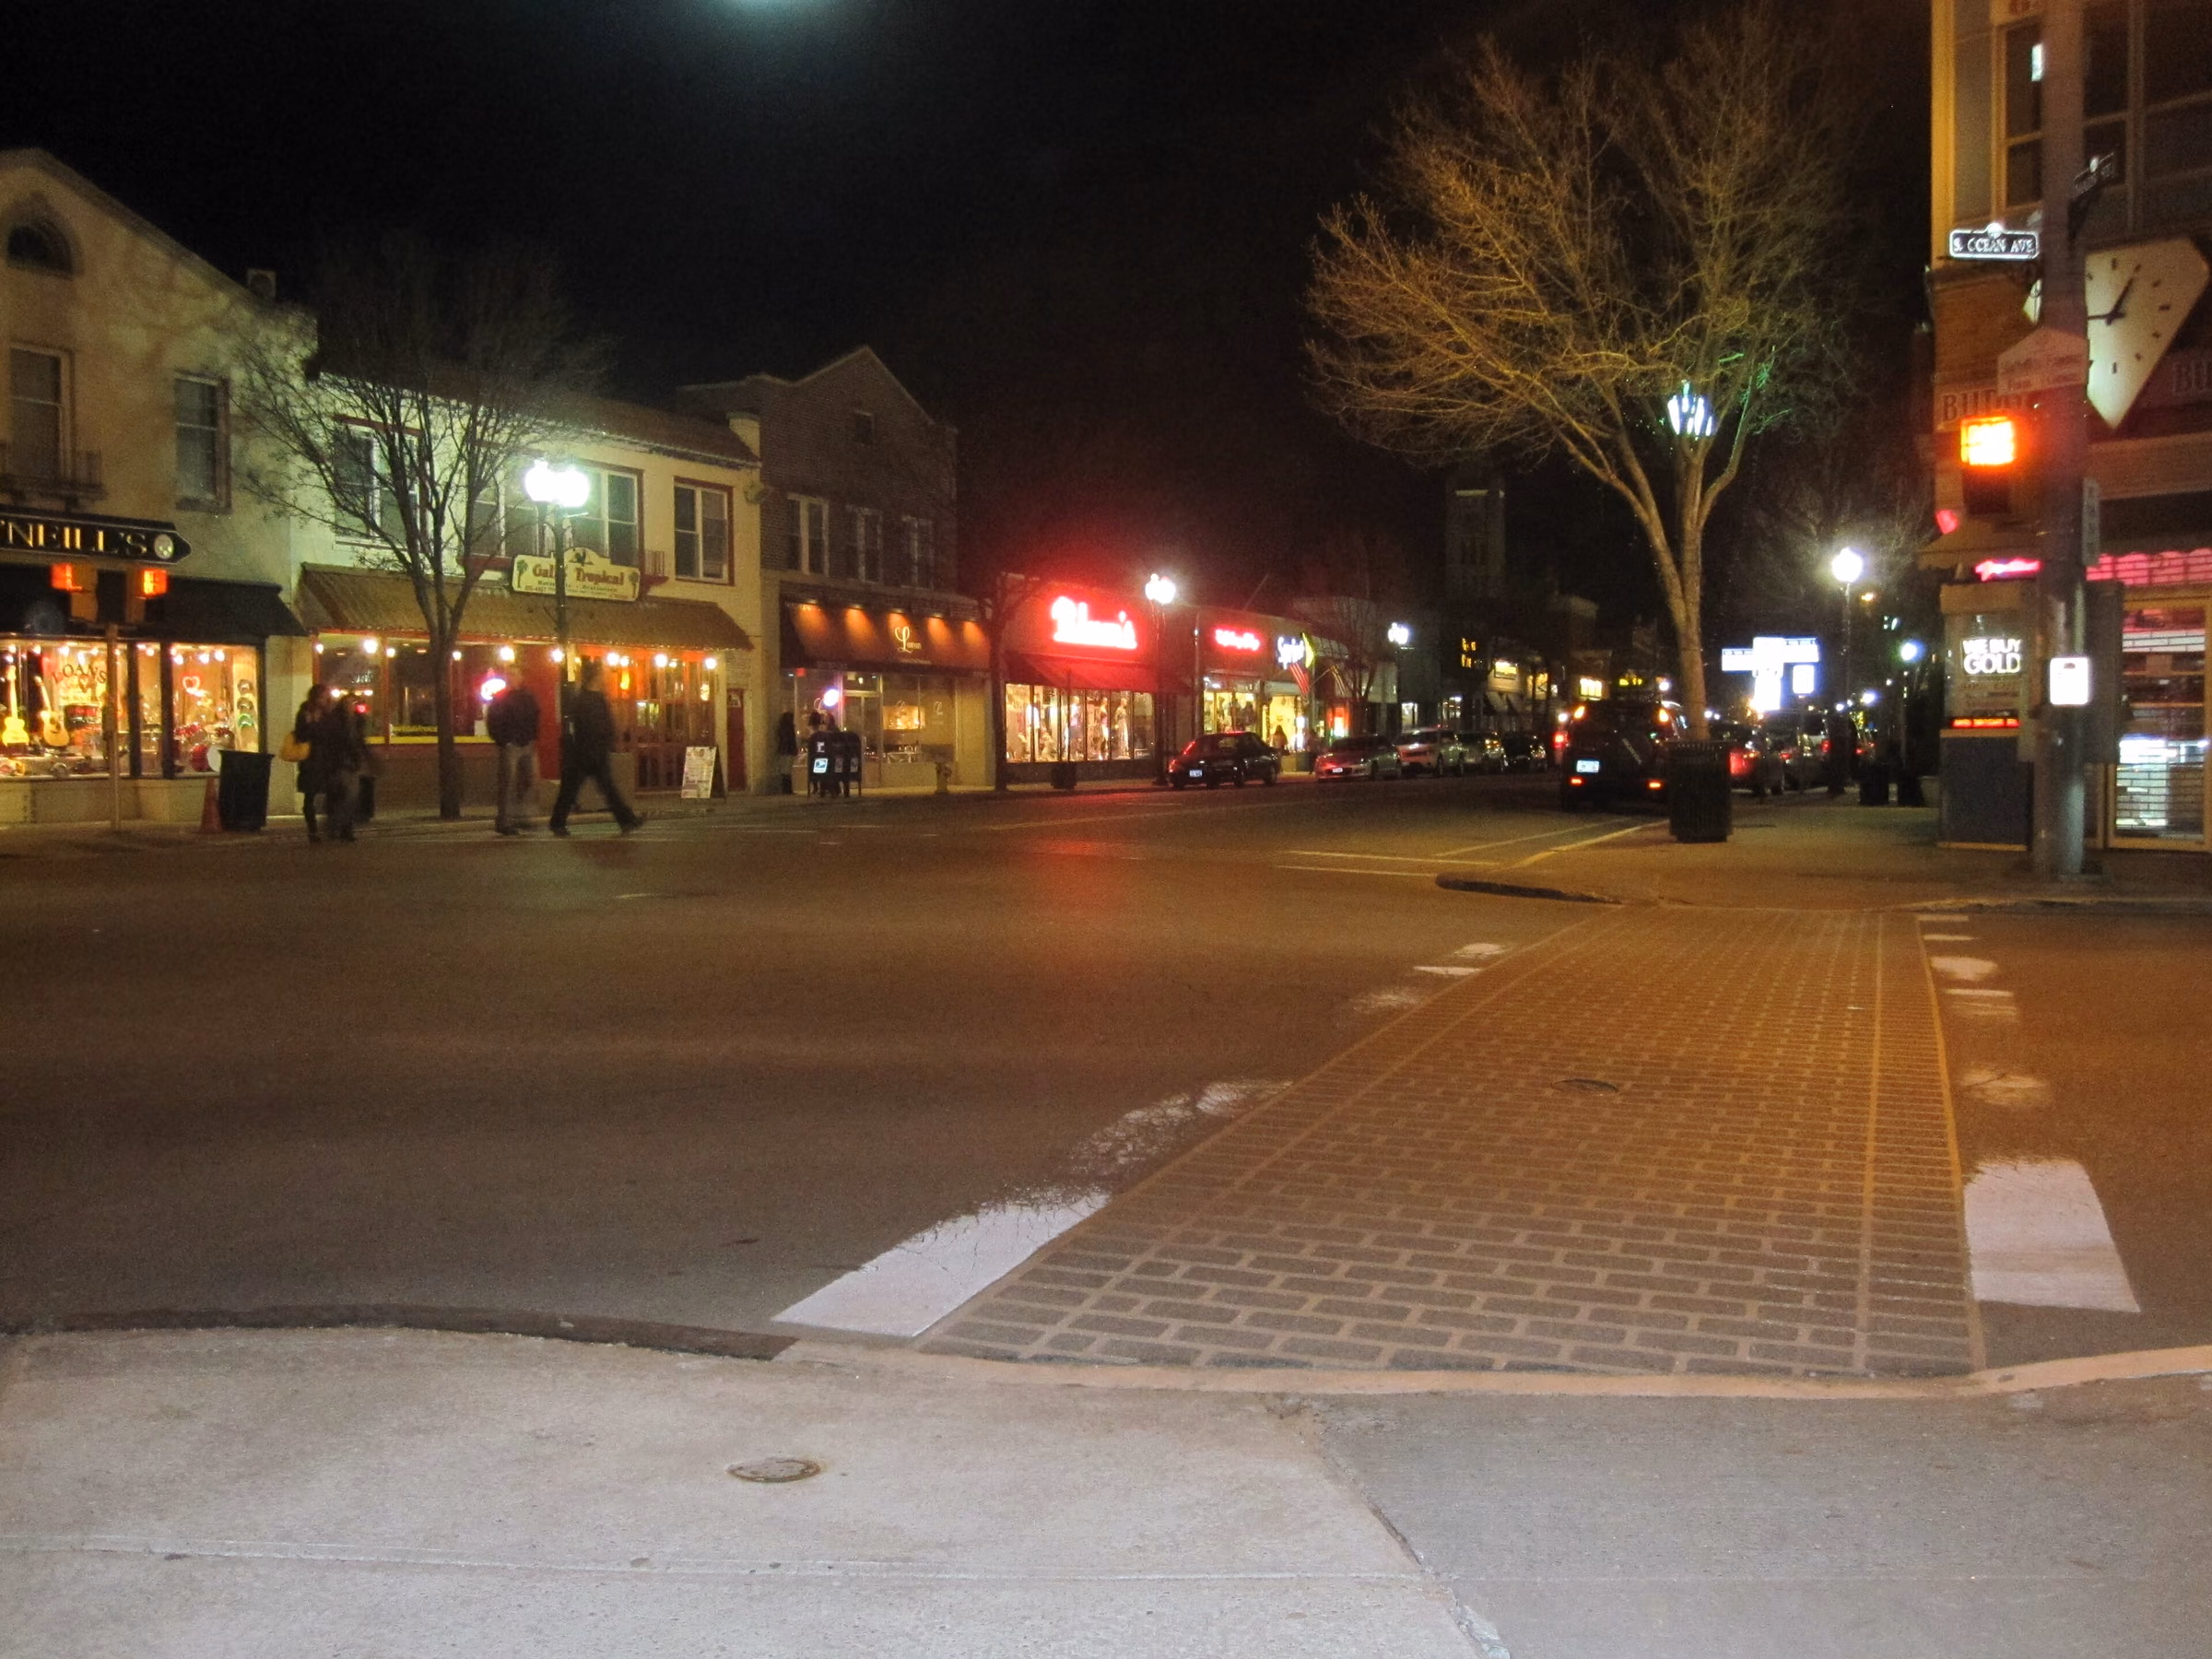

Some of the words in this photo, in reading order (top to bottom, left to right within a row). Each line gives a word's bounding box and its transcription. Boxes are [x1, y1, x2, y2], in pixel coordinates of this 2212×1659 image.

[1962, 639, 1988, 654] WE
[1989, 638, 2021, 653] BUY
[1963, 653, 2021, 675] GOLD
